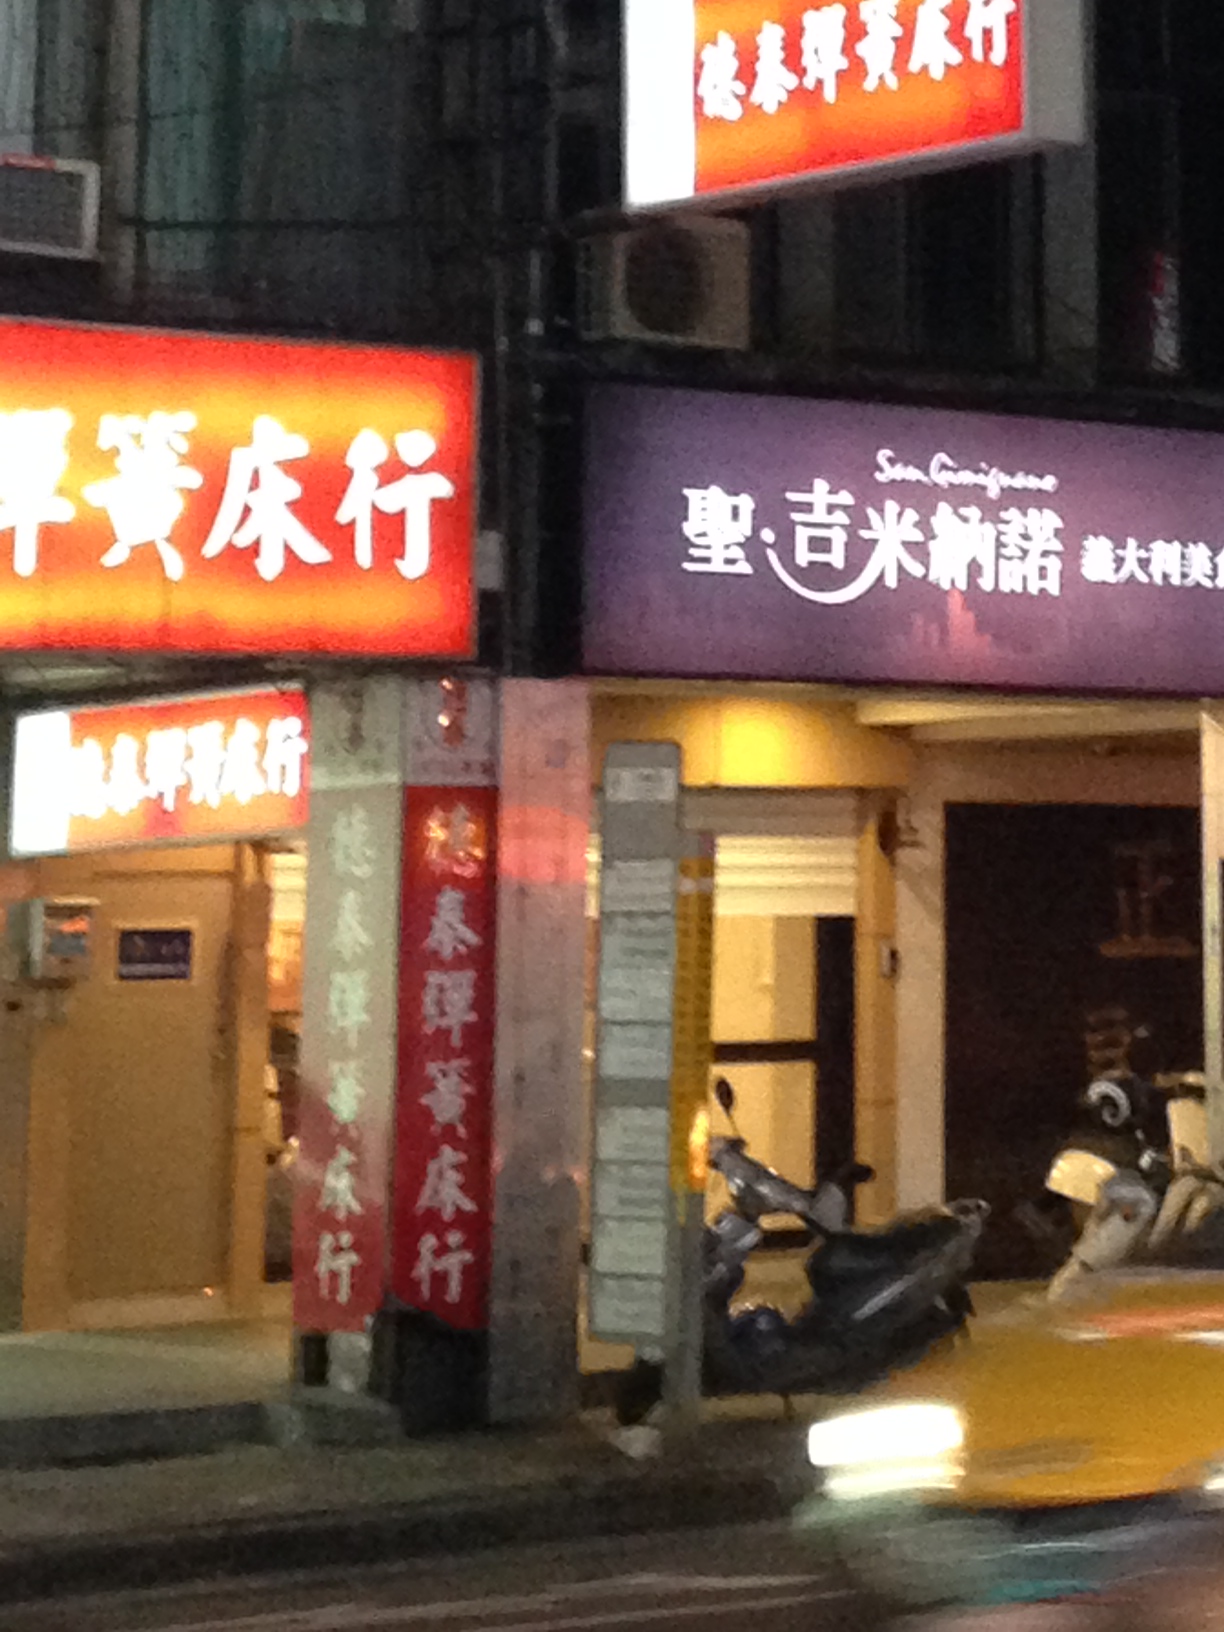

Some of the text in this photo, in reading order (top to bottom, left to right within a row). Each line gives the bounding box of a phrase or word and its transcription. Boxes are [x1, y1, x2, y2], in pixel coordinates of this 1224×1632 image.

[681, 478, 1064, 604] 聖吉米納諾
